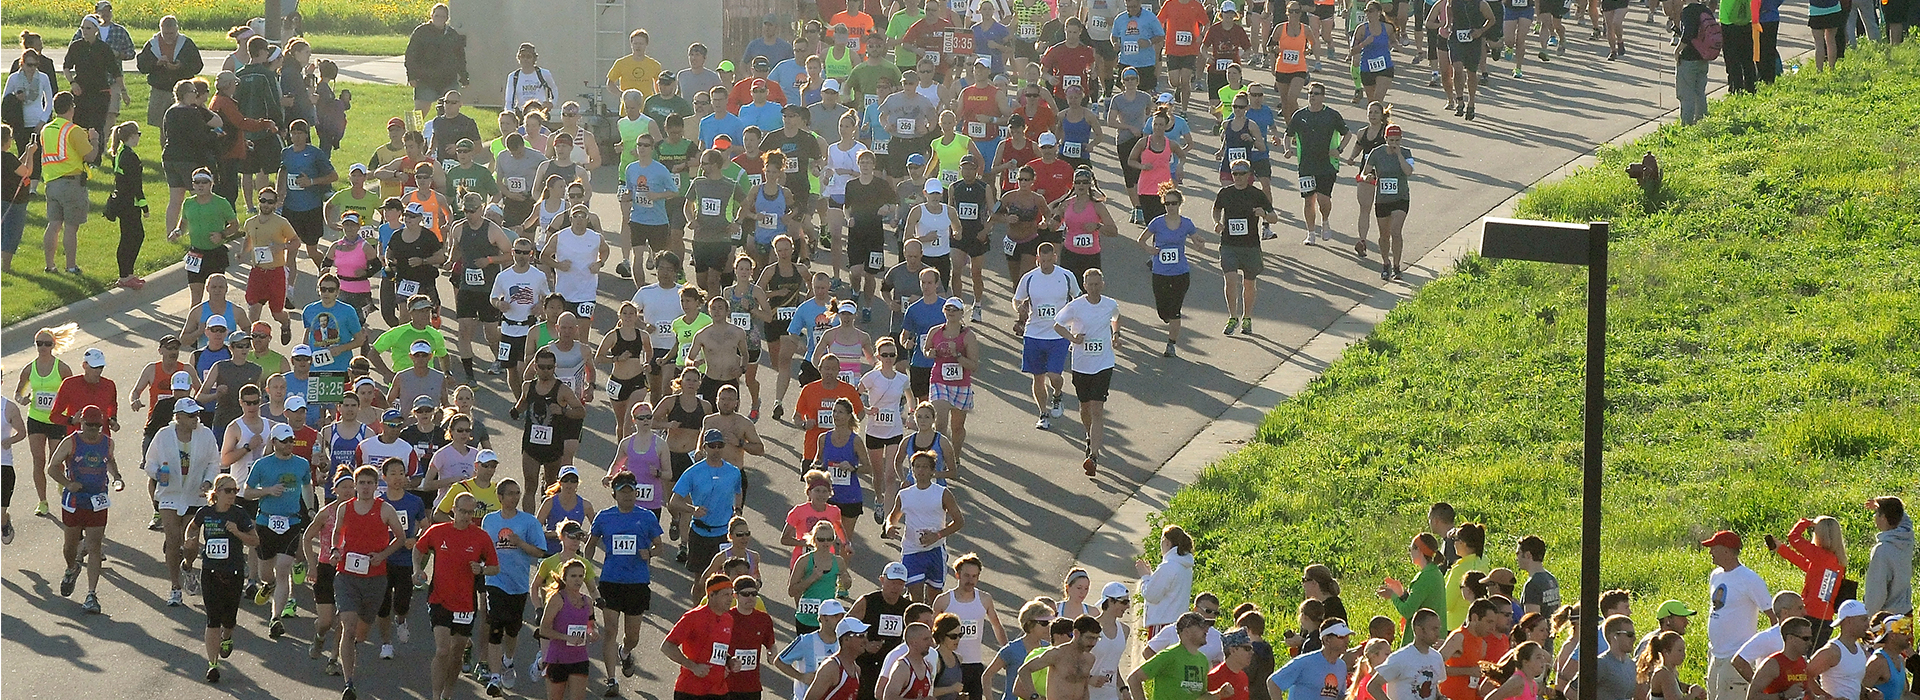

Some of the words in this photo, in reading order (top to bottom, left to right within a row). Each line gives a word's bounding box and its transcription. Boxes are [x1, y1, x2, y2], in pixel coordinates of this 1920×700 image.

[945, 33, 953, 52] GOAL
[954, 37, 973, 50] 3:35
[1075, 236, 1091, 247] 703
[260, 251, 265, 262] 2
[1161, 251, 1177, 262] 639
[1038, 307, 1055, 317] 1743
[658, 324, 672, 334] 352
[1084, 342, 1103, 353] 1635
[314, 353, 333, 365] 671
[946, 367, 959, 377] 284
[308, 377, 318, 401] GOAL
[318, 381, 343, 396] 3:25
[38, 396, 54, 406] 807
[819, 415, 834, 424] 100
[875, 412, 894, 423] 1081
[534, 429, 548, 441] 271
[272, 518, 286, 531] 392
[206, 543, 227, 554] 1219
[613, 540, 634, 551] 1417
[354, 557, 360, 568] 6
[799, 603, 819, 614] 1325
[884, 619, 899, 631] 337
[738, 655, 756, 666] 582
